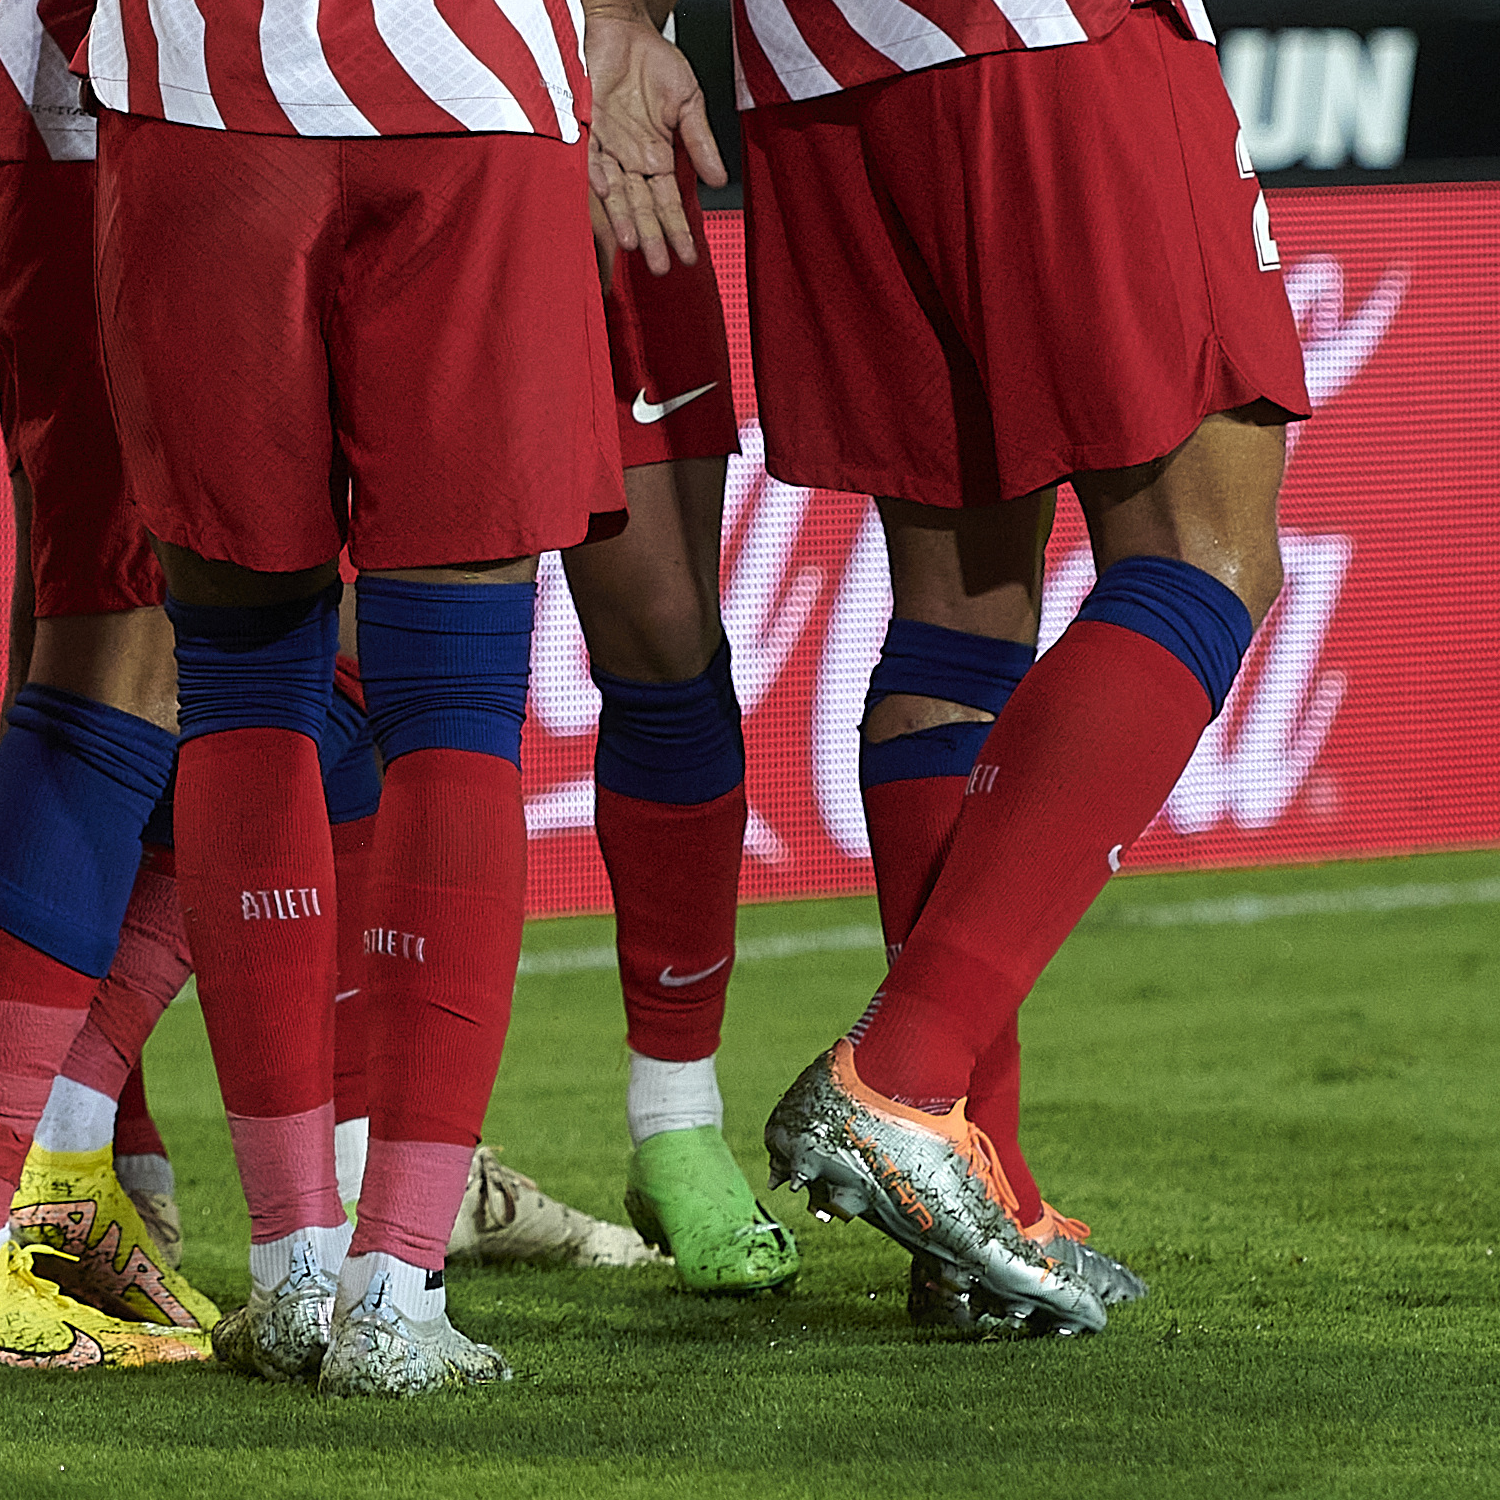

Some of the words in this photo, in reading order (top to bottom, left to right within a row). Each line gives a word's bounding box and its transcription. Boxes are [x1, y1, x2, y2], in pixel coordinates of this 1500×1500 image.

[1221, 26, 1420, 171] UN
[240, 888, 321, 920] ATLETI
[363, 927, 426, 963] ATLETI
